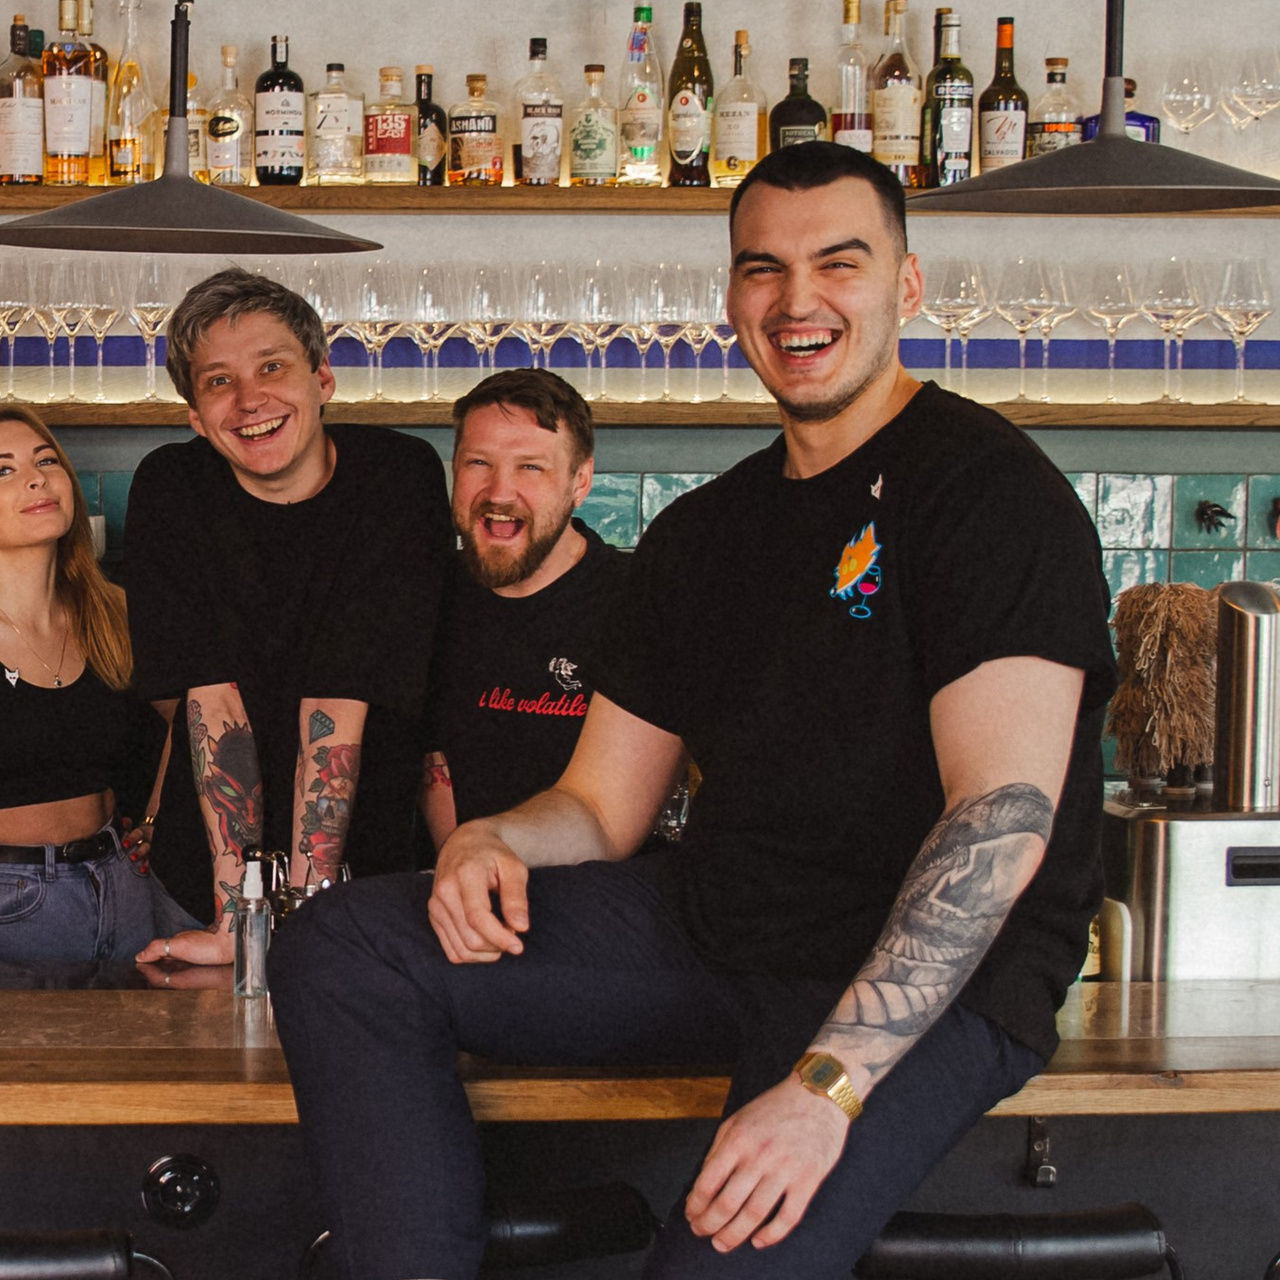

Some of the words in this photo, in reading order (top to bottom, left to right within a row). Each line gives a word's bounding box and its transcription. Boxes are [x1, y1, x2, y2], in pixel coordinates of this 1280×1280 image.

[376, 129, 406, 138] EAST
[983, 148, 1019, 156] CALVADOS
[479, 691, 487, 707] i
[489, 687, 514, 711] like
[517, 692, 588, 716] volatile
